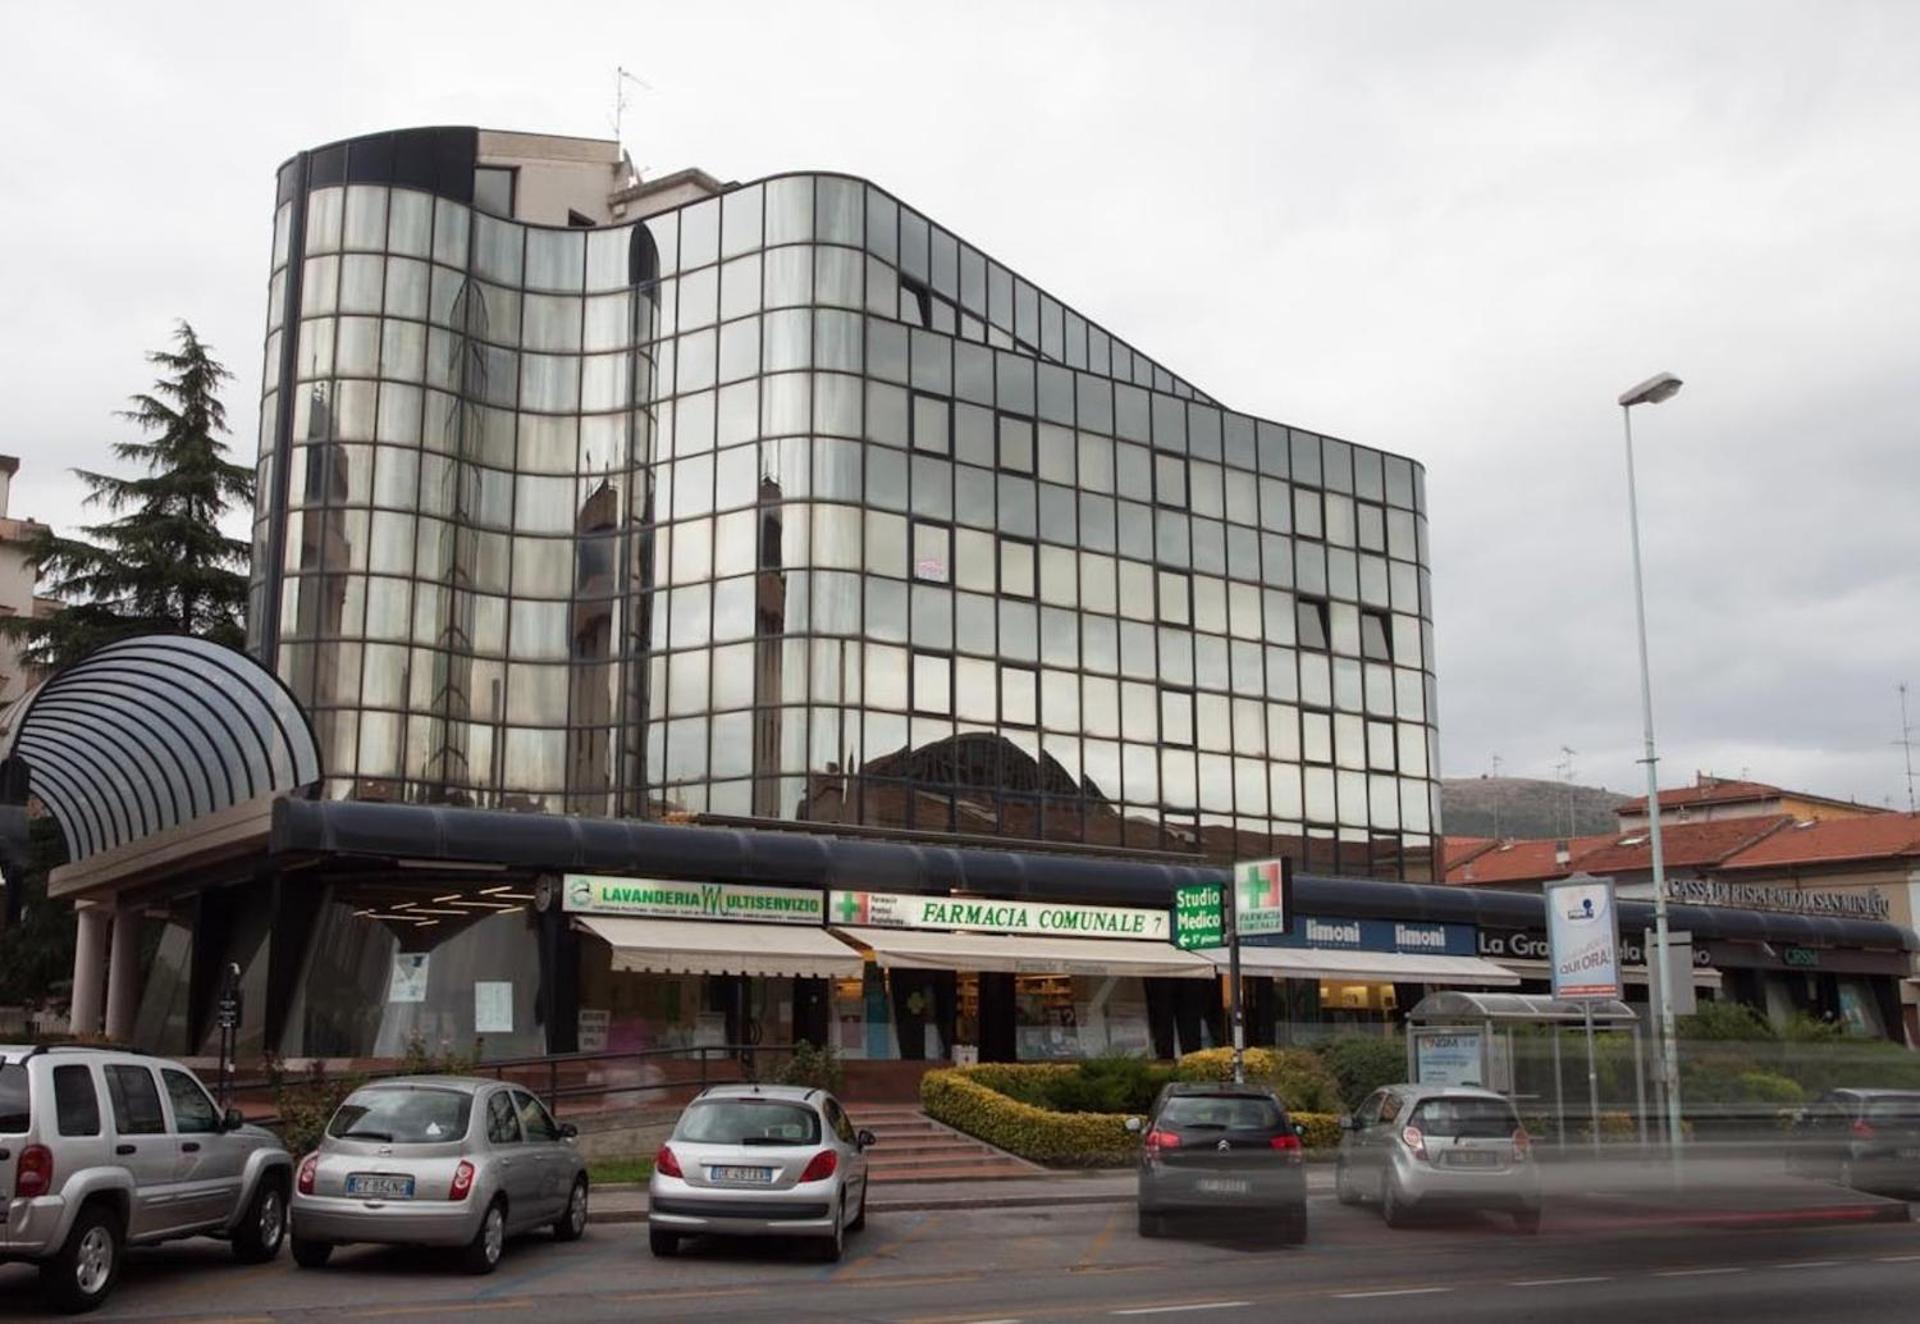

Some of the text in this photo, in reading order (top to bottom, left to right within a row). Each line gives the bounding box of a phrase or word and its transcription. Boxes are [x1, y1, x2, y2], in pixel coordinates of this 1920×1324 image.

[602, 887, 700, 906] LAVANDERIA
[1176, 889, 1220, 908] Studio
[922, 902, 1028, 927] FARMACIA
[1039, 910, 1145, 933] COMUNALE
[1154, 917, 1162, 932] 7
[1177, 911, 1221, 931] Medico
[1239, 911, 1280, 921] FARMACIA
[1306, 919, 1360, 943] limoni
[1395, 924, 1445, 947] limoni
[1479, 932, 1504, 954] La
[1509, 933, 1549, 957] Gra
